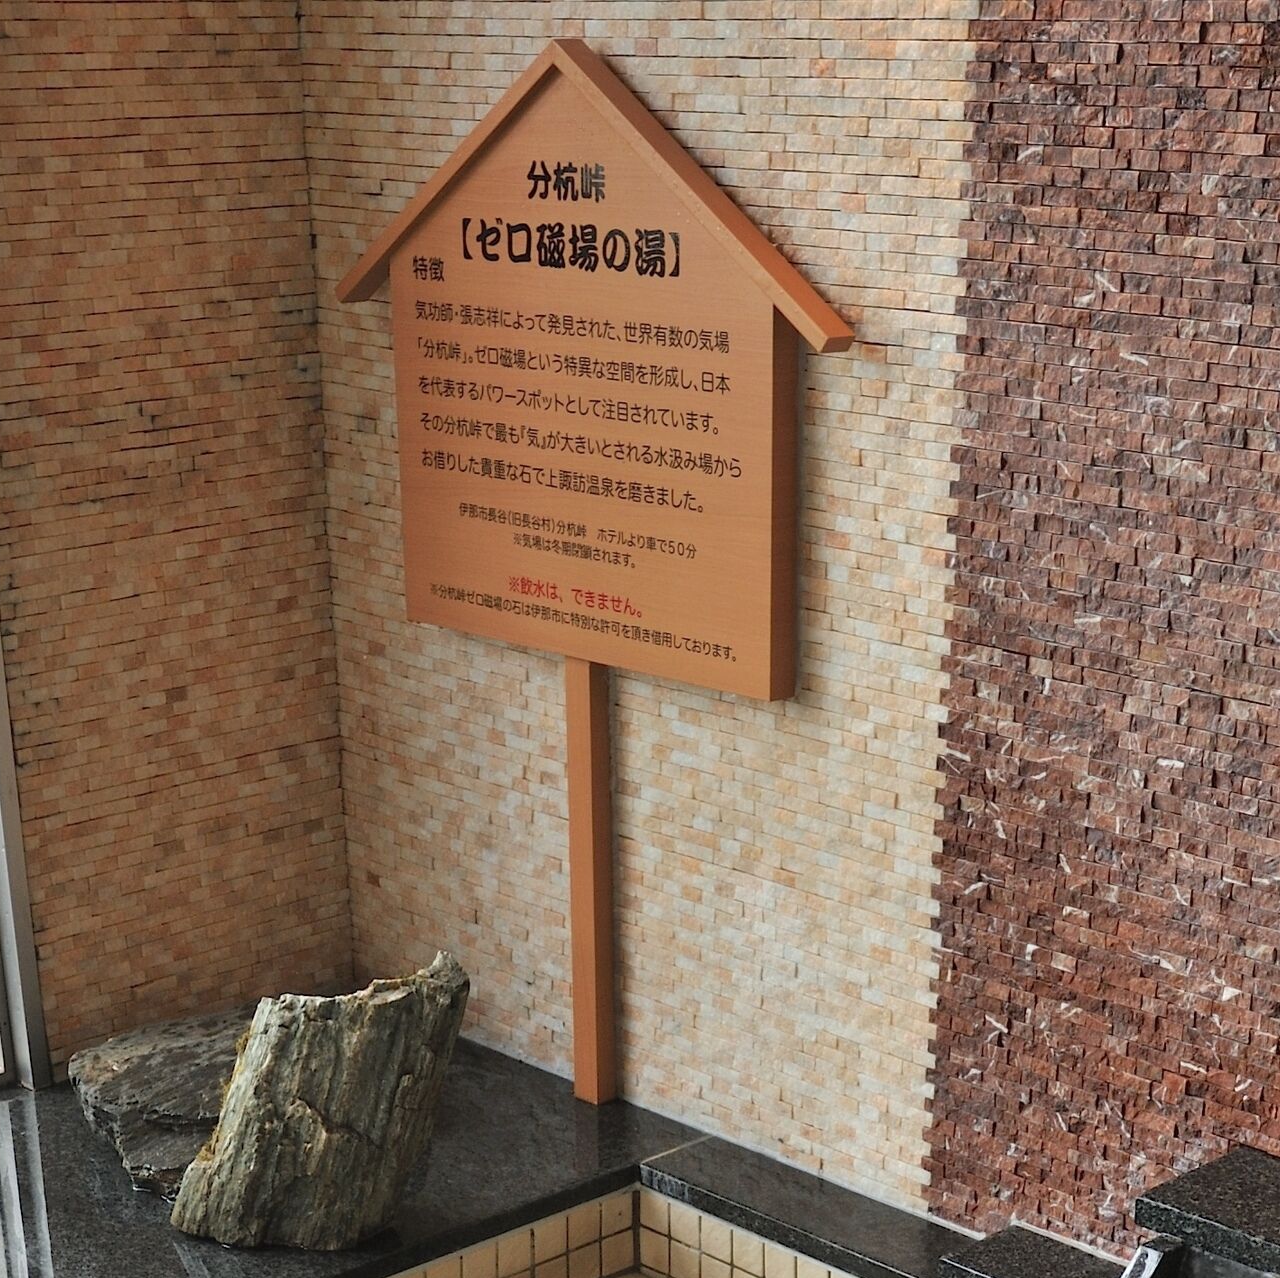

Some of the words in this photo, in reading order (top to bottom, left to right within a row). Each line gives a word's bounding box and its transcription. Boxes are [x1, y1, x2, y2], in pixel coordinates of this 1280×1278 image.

[527, 160, 606, 203] 分杭峠
[412, 256, 445, 282] 特徴
[462, 217, 681, 278] 【ゼロ磁場の湯】
[418, 376, 720, 436] を代表するパワースポットとして注目されています。
[420, 412, 742, 479] その分杭峠で最も『気』が大きいとされる水汲み場から
[421, 448, 705, 513] お借りした貴重な石で上諏訪温泉を磨きました。
